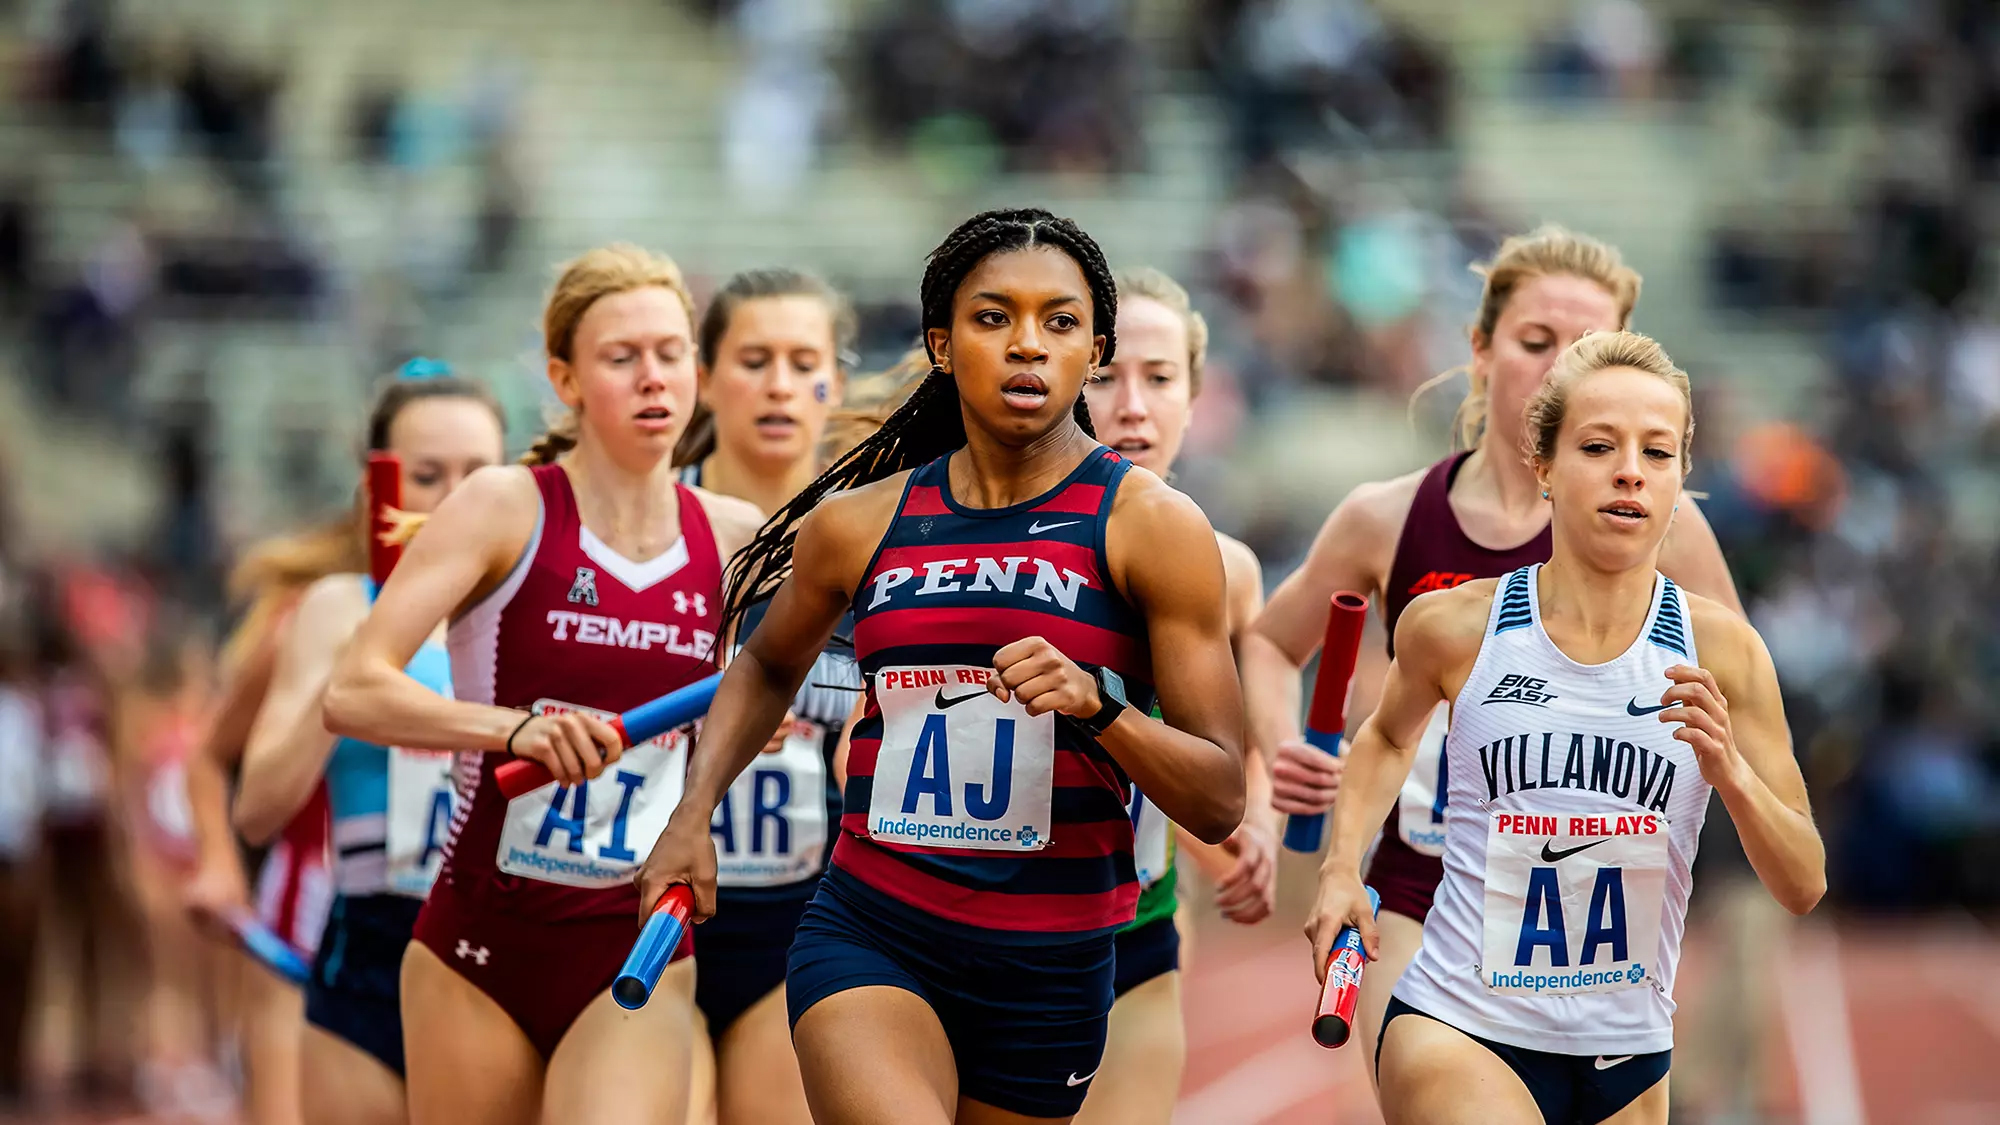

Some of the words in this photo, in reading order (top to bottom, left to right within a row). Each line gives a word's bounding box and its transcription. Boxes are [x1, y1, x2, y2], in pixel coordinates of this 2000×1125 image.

[868, 556, 1089, 612] PENN
[547, 610, 716, 663] TEMPLE
[885, 669, 947, 690] PENN
[1487, 688, 1559, 704] EAST
[1497, 674, 1548, 689] BIG
[901, 714, 1015, 821] AJ
[1478, 732, 1677, 814] VILLANOVA
[535, 770, 646, 862] AI
[878, 817, 1012, 842] Independence
[1498, 814, 1557, 836] PENN
[1569, 815, 1657, 836] RELAYS
[1514, 867, 1628, 967] AA
[1493, 970, 1623, 992] Independence
